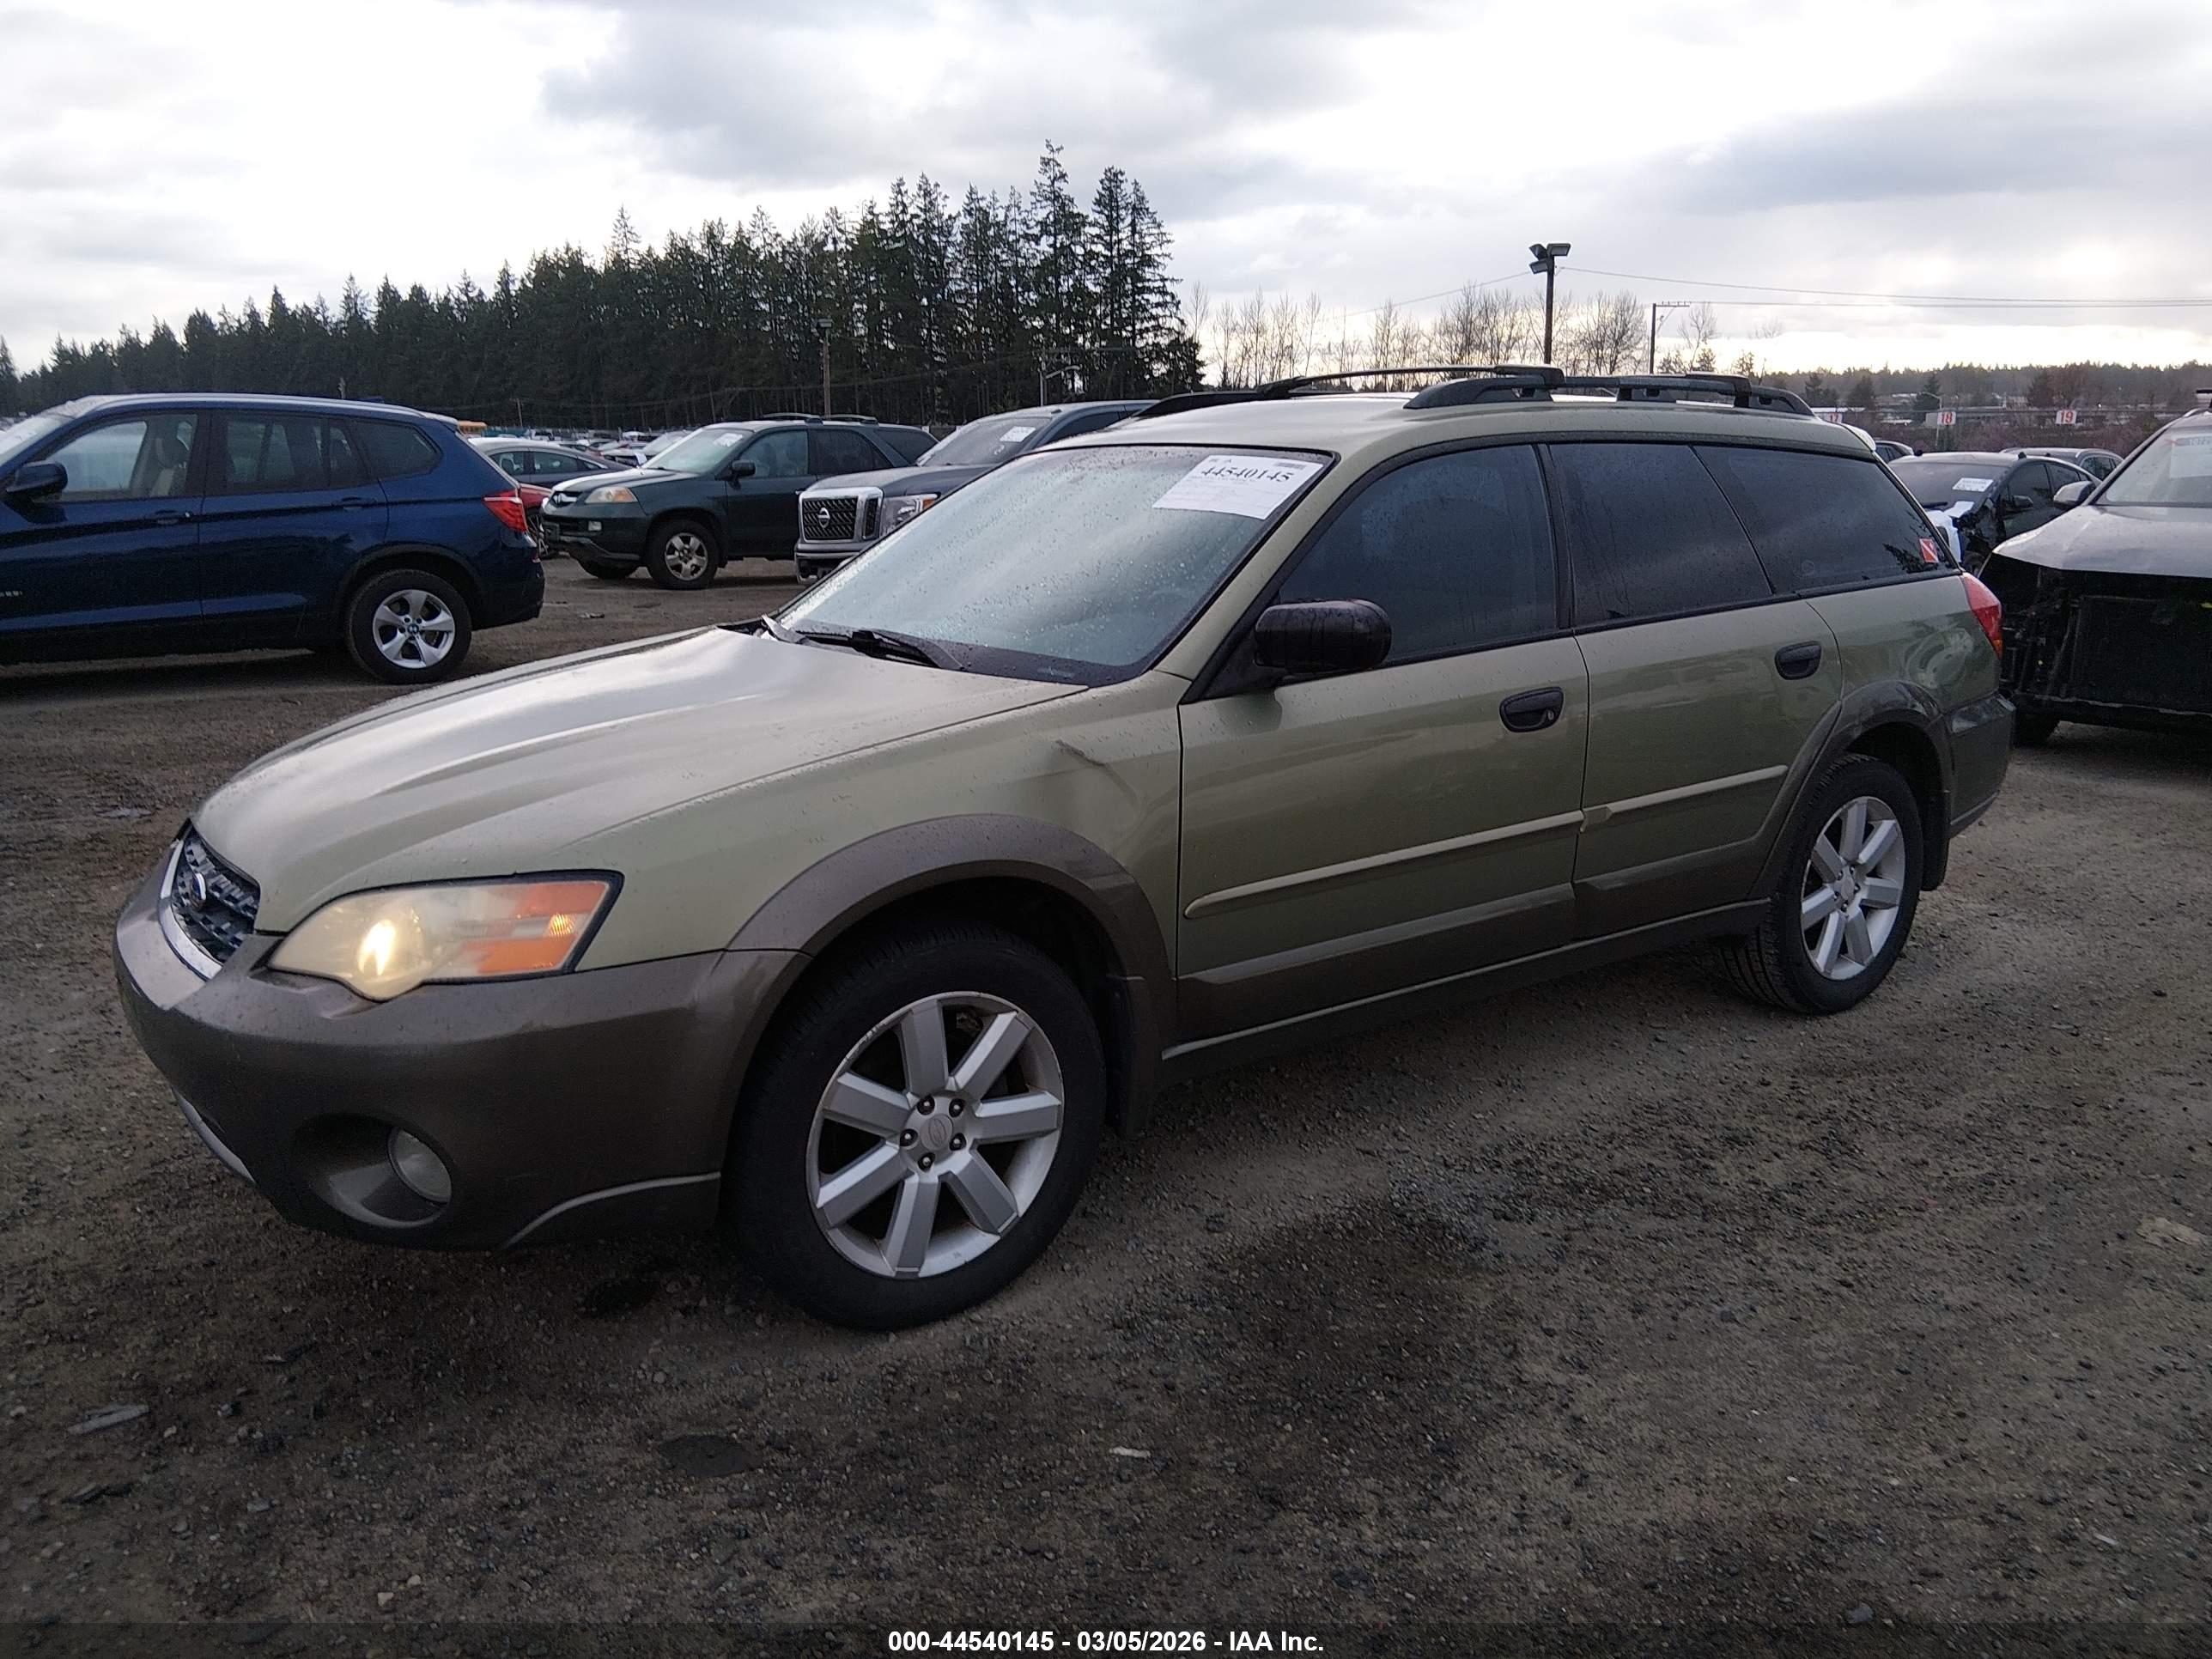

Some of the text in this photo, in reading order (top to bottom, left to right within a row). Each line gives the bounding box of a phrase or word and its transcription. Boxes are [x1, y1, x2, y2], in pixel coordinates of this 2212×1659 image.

[1941, 412, 1953, 424] 18
[2060, 410, 2074, 423] 19
[1201, 466, 1294, 483] 44540145
